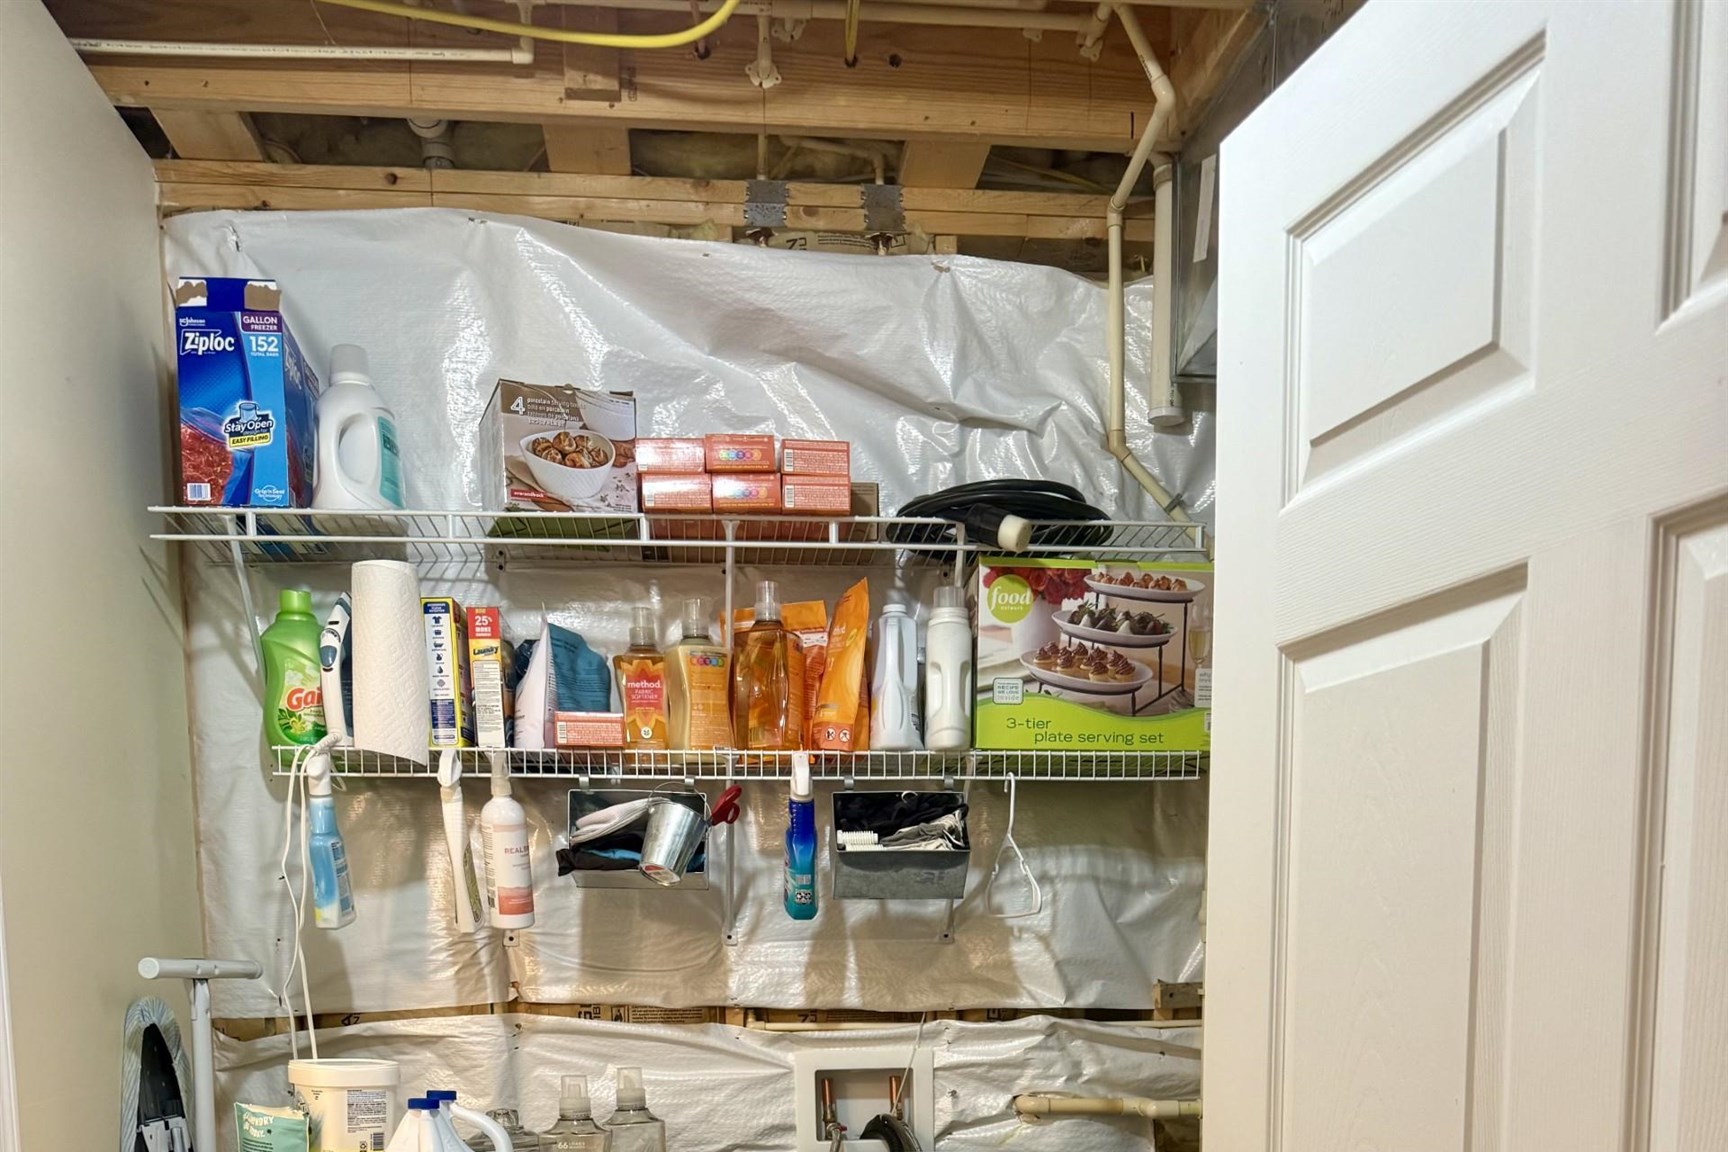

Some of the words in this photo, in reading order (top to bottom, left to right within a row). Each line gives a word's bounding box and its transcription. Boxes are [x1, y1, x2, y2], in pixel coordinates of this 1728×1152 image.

[243, 316, 278, 324] GALLON
[184, 332, 235, 355] Ziploc
[250, 336, 279, 352] 152
[511, 396, 526, 415] 4
[225, 422, 247, 434] Stay
[247, 420, 273, 431] Open
[247, 434, 269, 443] FILLING
[991, 586, 1032, 611] food
[287, 687, 323, 711] Gai
[1006, 717, 1052, 729] 3-tier
[1034, 731, 1073, 744] plate
[1078, 731, 1134, 745] serving
[1139, 732, 1164, 744] set
[558, 1141, 568, 1149] 66
